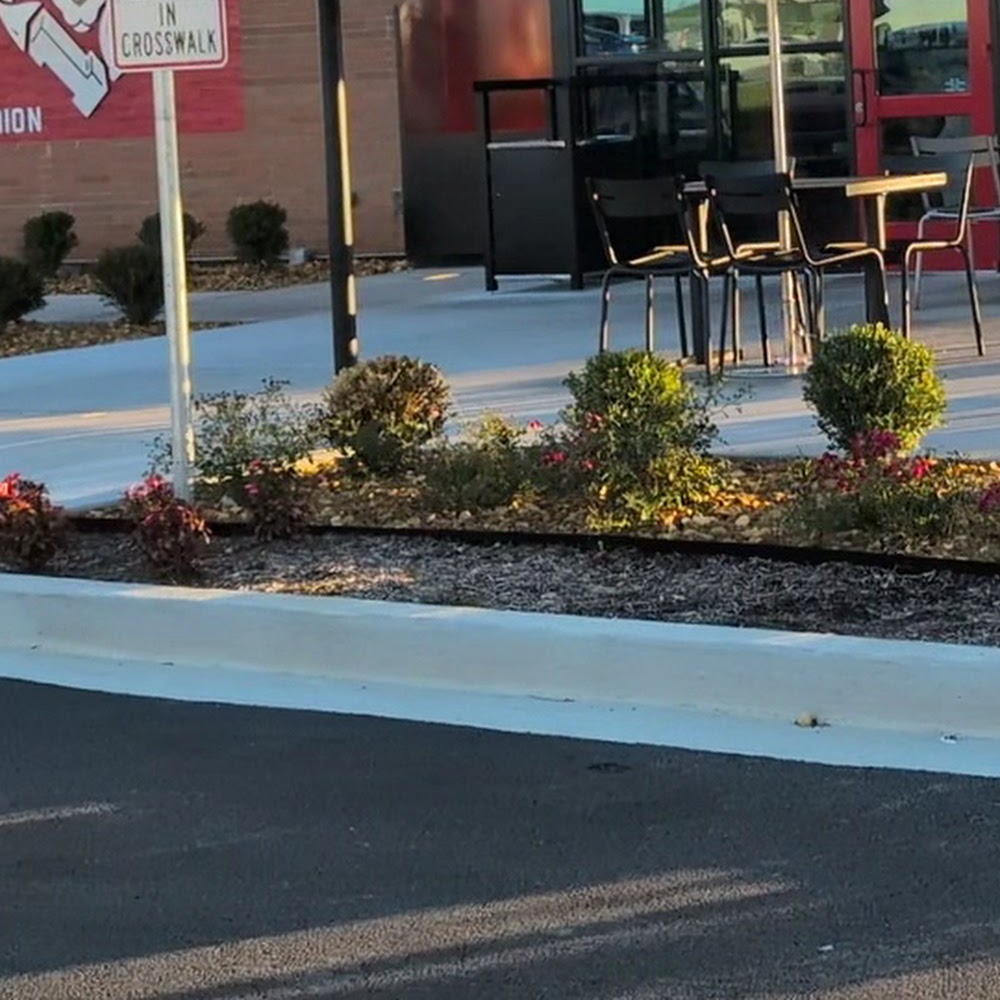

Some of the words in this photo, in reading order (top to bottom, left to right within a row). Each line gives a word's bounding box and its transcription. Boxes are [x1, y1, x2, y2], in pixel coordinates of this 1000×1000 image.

[158, 1, 177, 27] IN
[121, 29, 218, 58] CROSSWALK
[0, 106, 43, 135] ION
